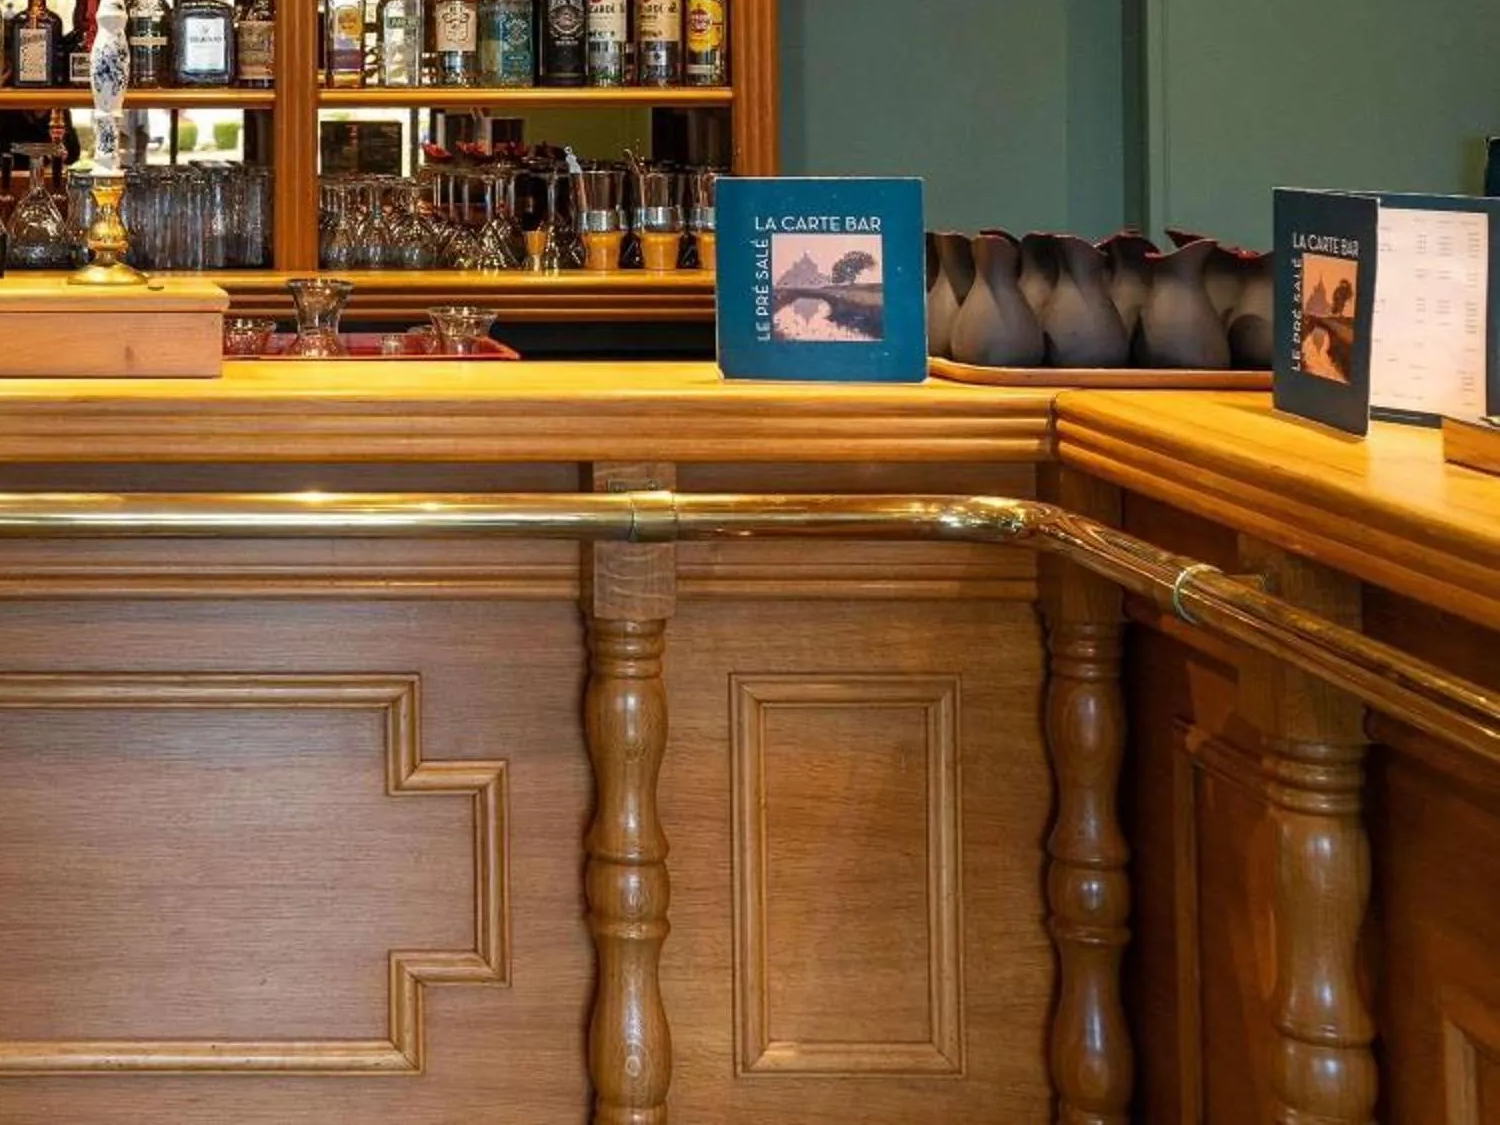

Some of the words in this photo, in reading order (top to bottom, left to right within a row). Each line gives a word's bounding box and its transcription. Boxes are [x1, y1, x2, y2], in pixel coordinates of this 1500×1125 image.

[755, 217, 777, 231] LA
[781, 216, 841, 232] CARTE
[846, 216, 882, 232] BAR
[1292, 232, 1308, 249] LA
[1308, 234, 1340, 254] CARTE
[1342, 239, 1359, 257] BAR
[753, 237, 770, 280] SALÉ
[753, 286, 770, 317] PRÉ
[757, 321, 771, 342] LE
[1291, 349, 1302, 372] LE
